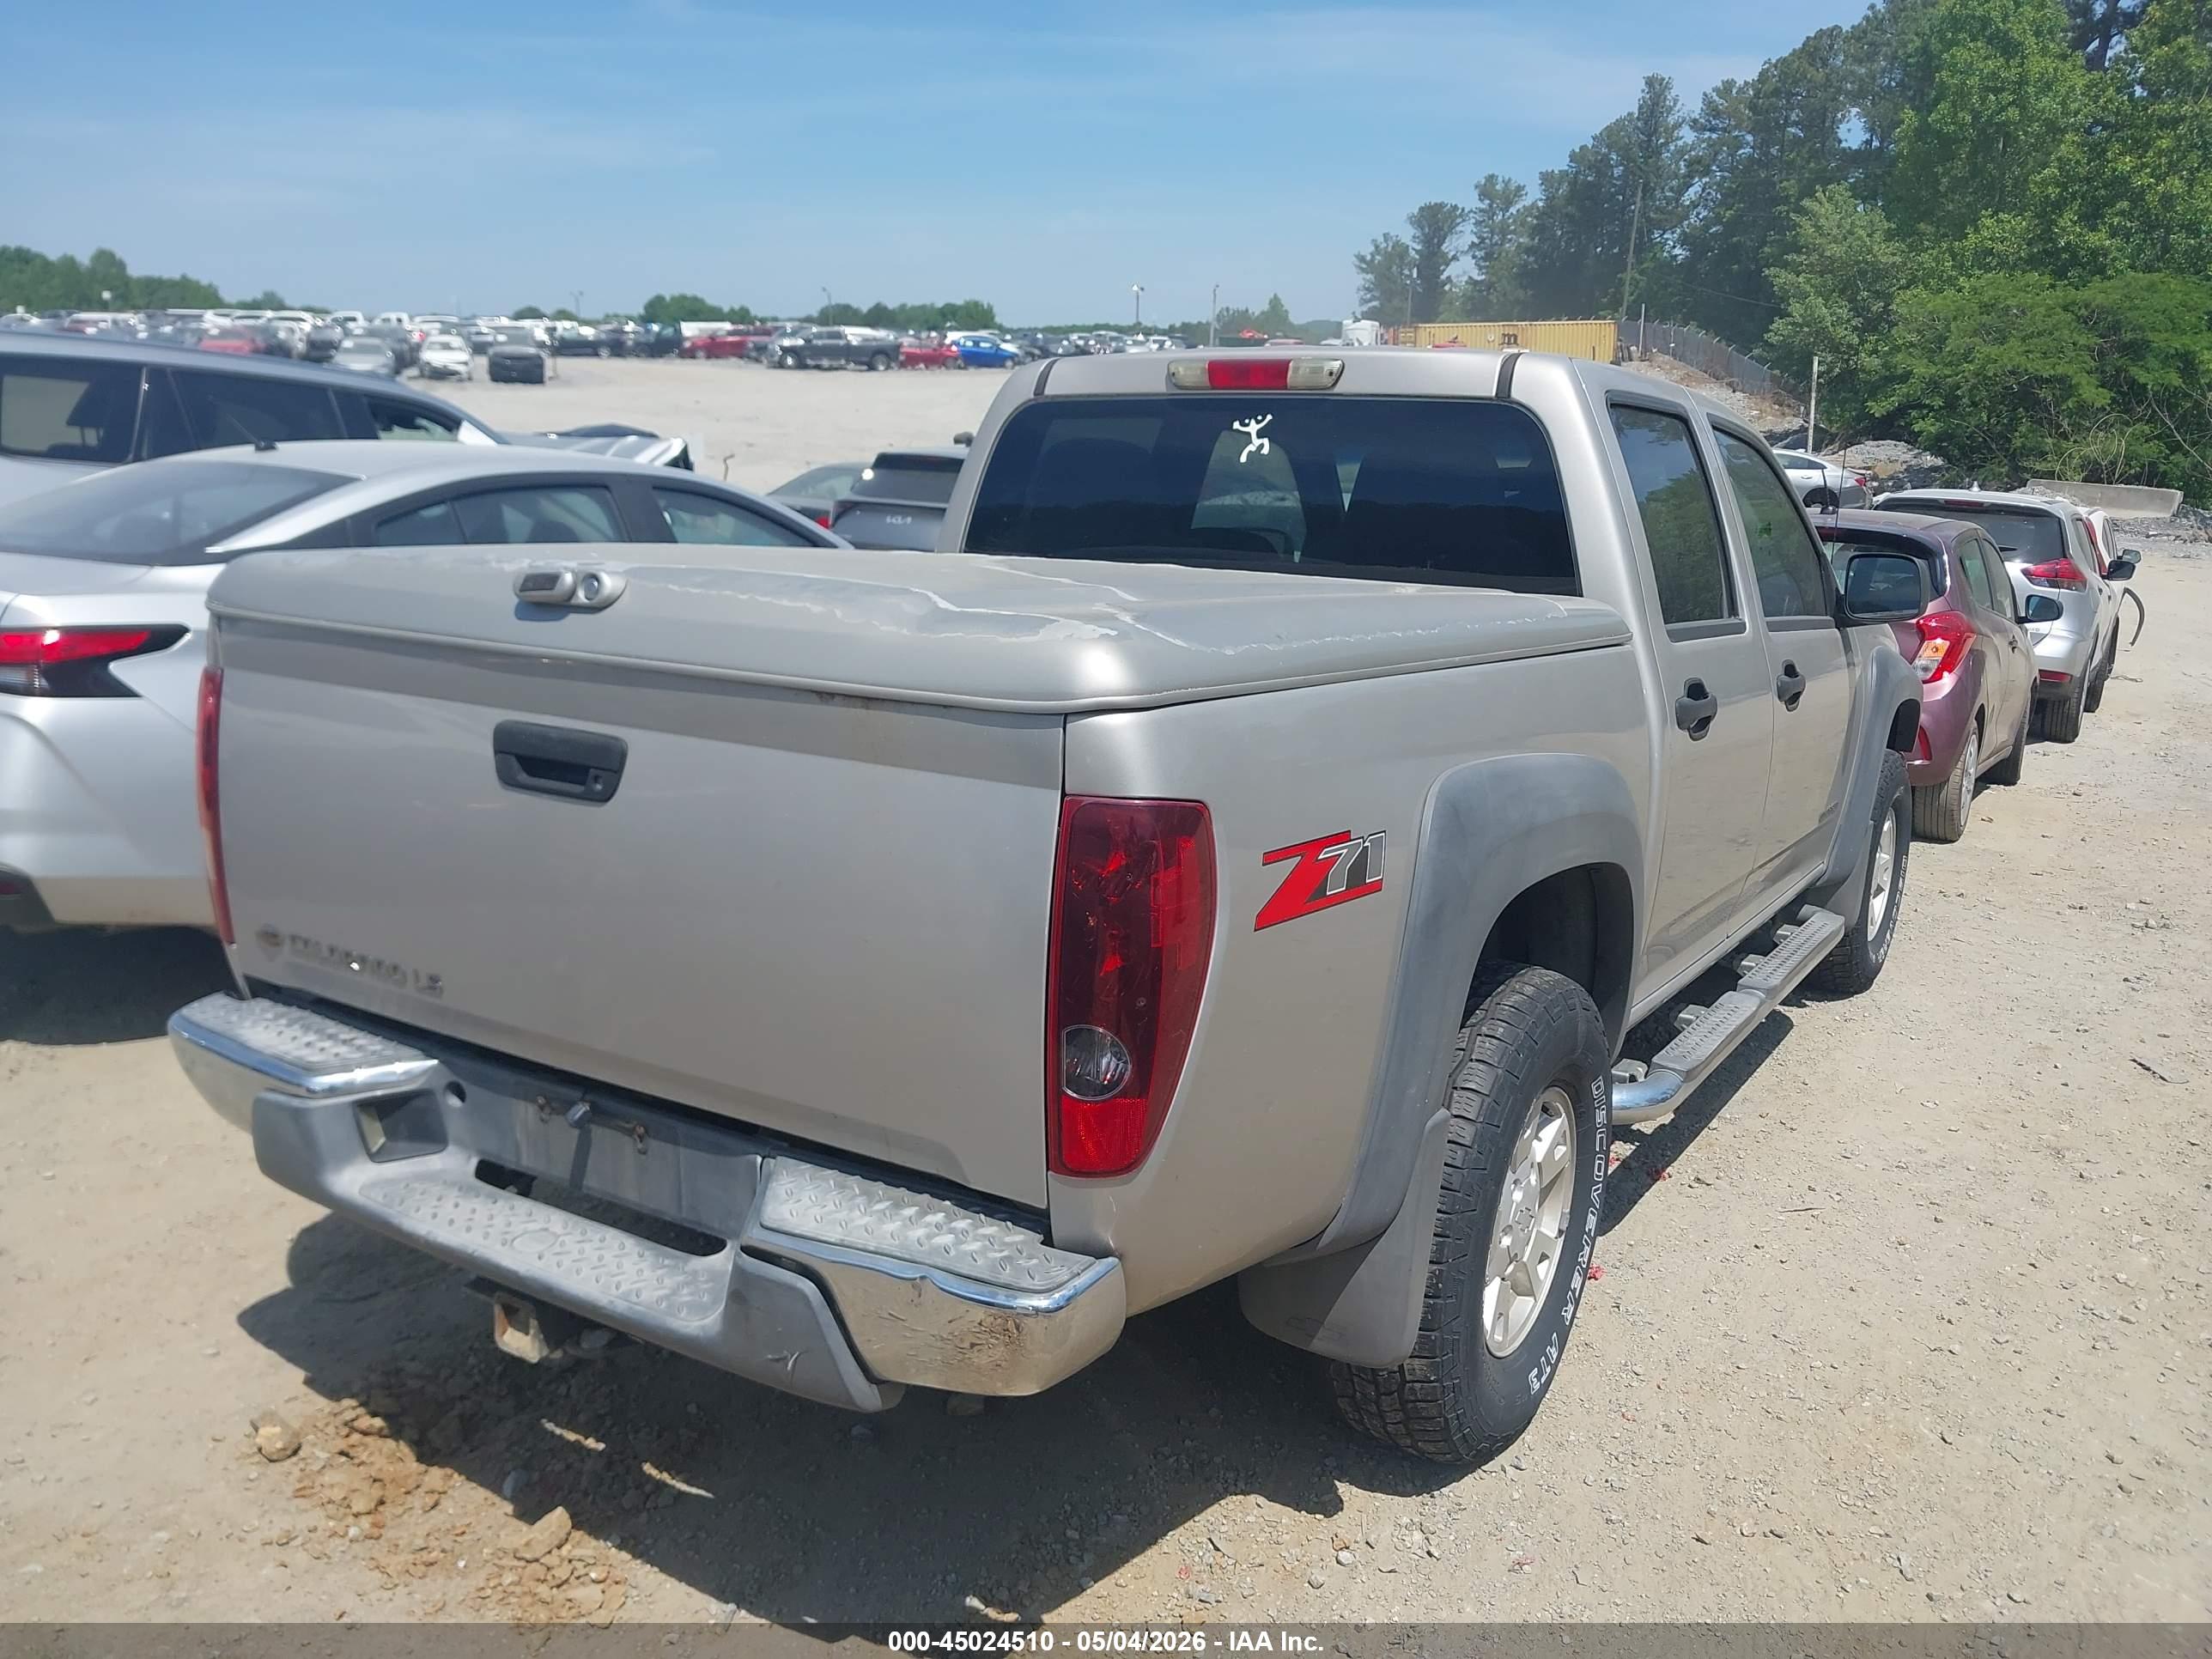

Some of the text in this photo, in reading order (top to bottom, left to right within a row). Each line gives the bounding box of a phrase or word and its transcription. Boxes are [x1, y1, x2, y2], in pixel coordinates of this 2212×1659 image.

[1254, 830, 1387, 933] Z71
[1528, 1075, 1607, 1396] DISCOVERER AT3
